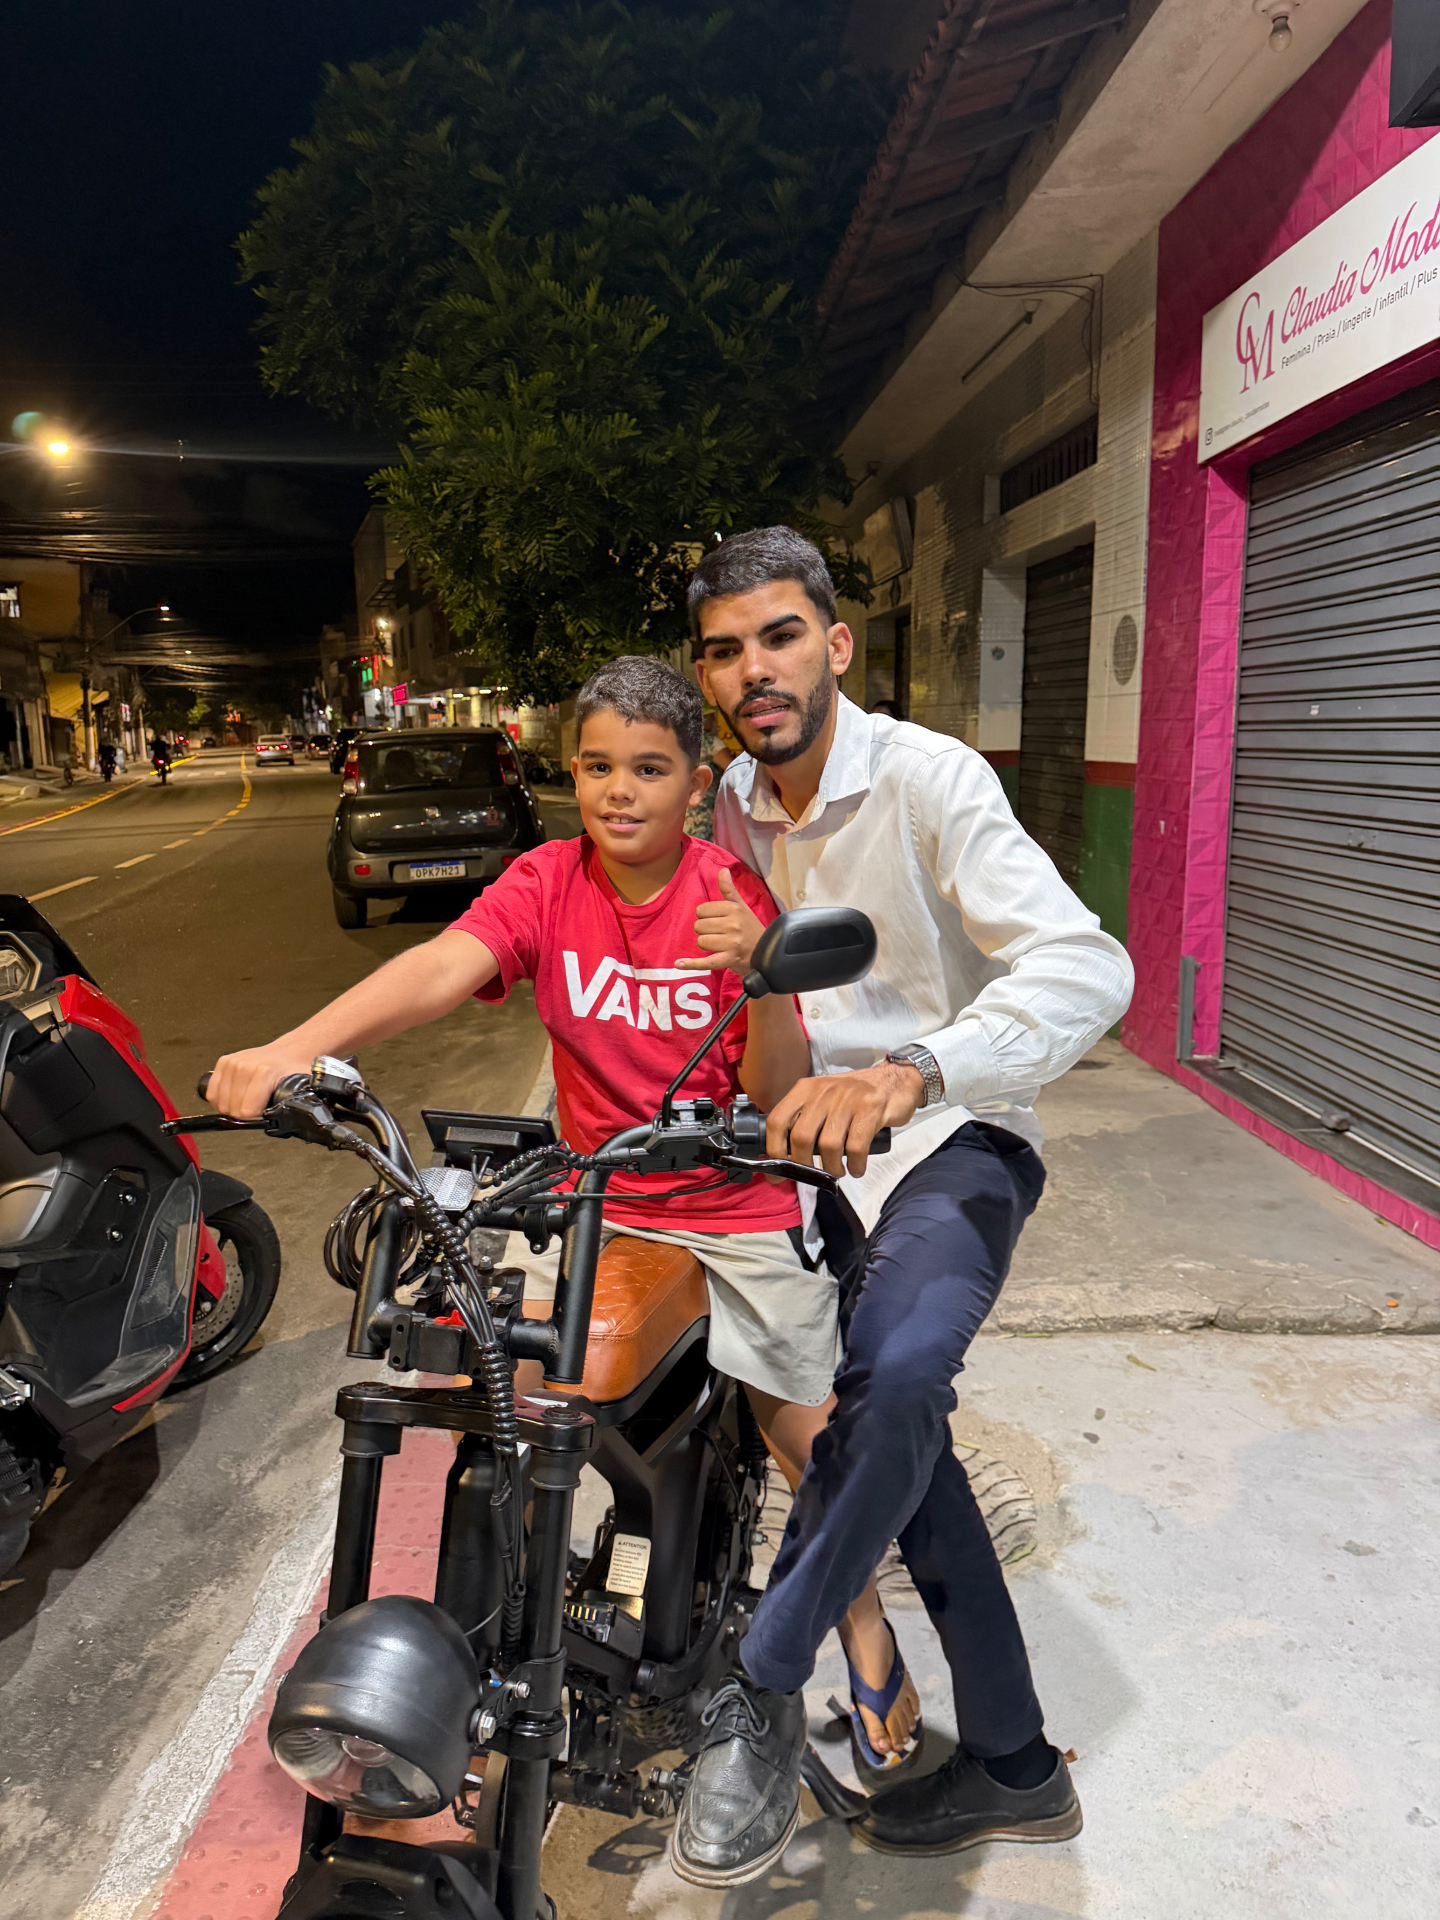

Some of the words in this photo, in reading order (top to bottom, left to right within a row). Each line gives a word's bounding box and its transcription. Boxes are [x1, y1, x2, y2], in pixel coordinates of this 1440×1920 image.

[1236, 291, 1275, 394] CM
[1281, 260, 1358, 344] Claudia
[1281, 344, 1311, 369] Feminina
[1317, 328, 1336, 347] Praia
[1343, 306, 1372, 332] lingerie
[1379, 281, 1409, 310] infantil
[1417, 268, 1438, 288] Plus
[415, 866, 460, 878] OPK7H21
[563, 950, 713, 1031] VANS
[622, 1541, 647, 1549] ATTENTION
